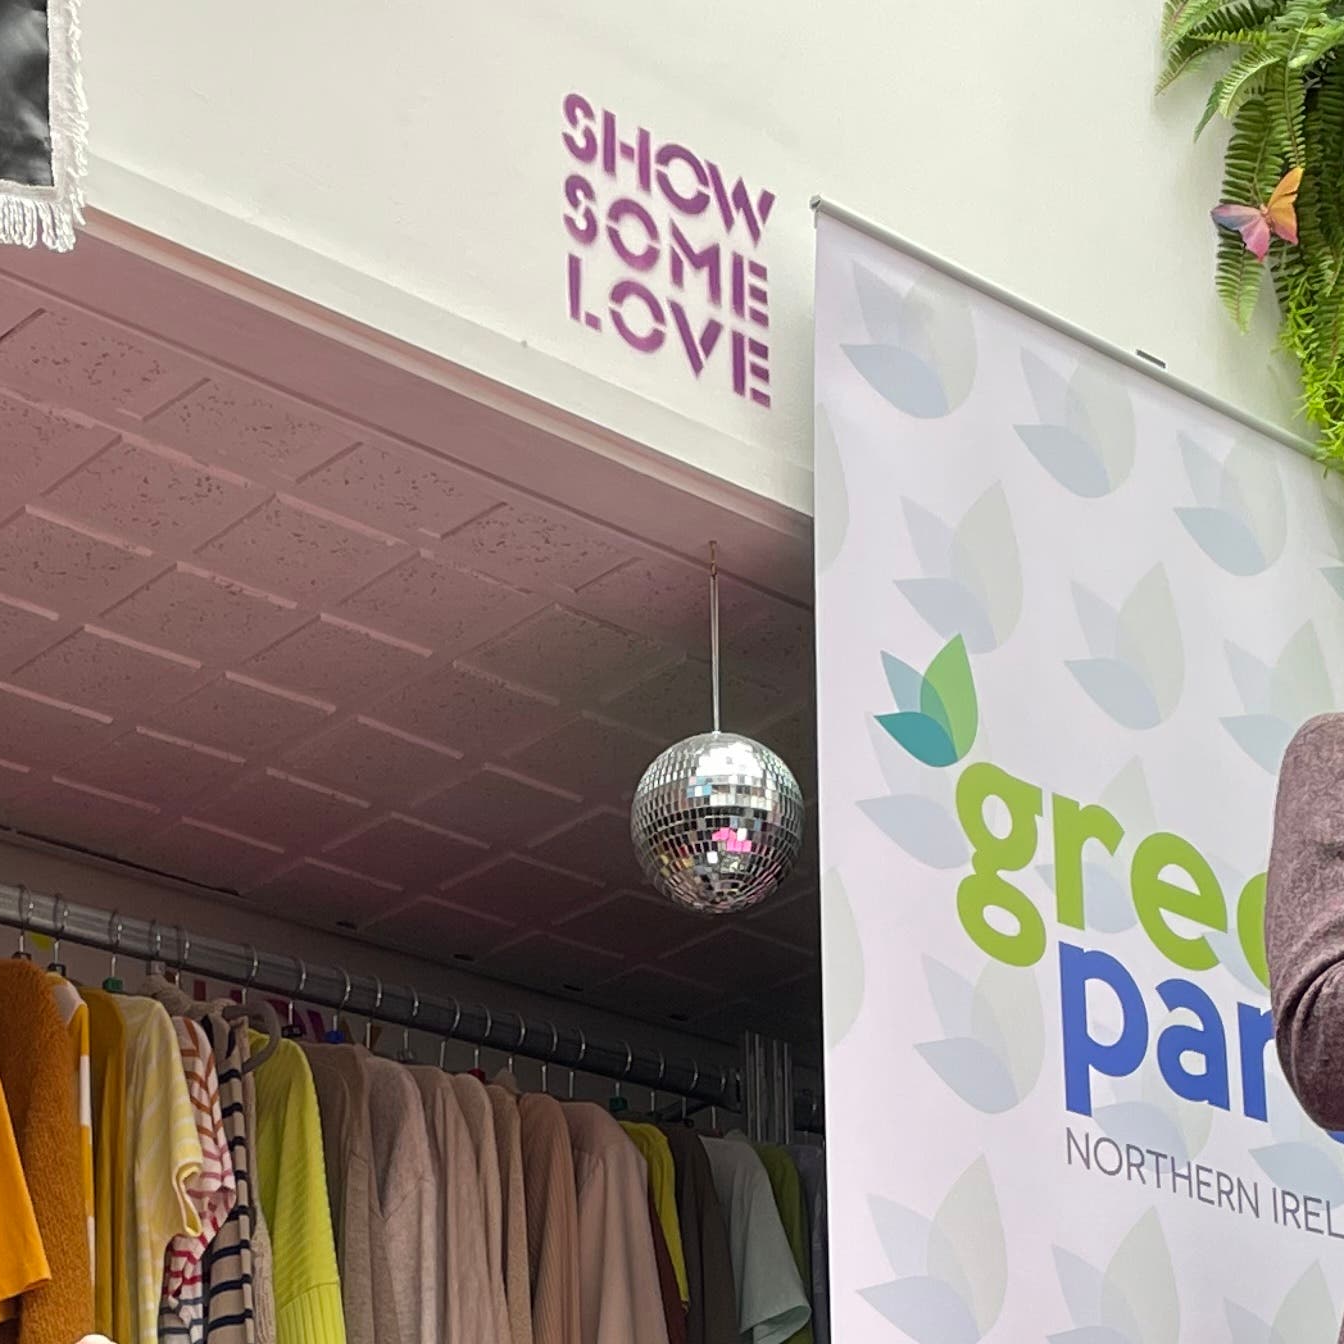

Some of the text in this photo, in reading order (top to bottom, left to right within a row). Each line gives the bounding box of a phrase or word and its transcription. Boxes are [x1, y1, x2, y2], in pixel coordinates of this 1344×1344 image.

[562, 93, 776, 248] SHOW
[563, 174, 769, 328] SOME
[567, 253, 771, 409] LOVE
[956, 762, 1268, 990] gre
[1066, 1127, 1260, 1219] NORTHERN
